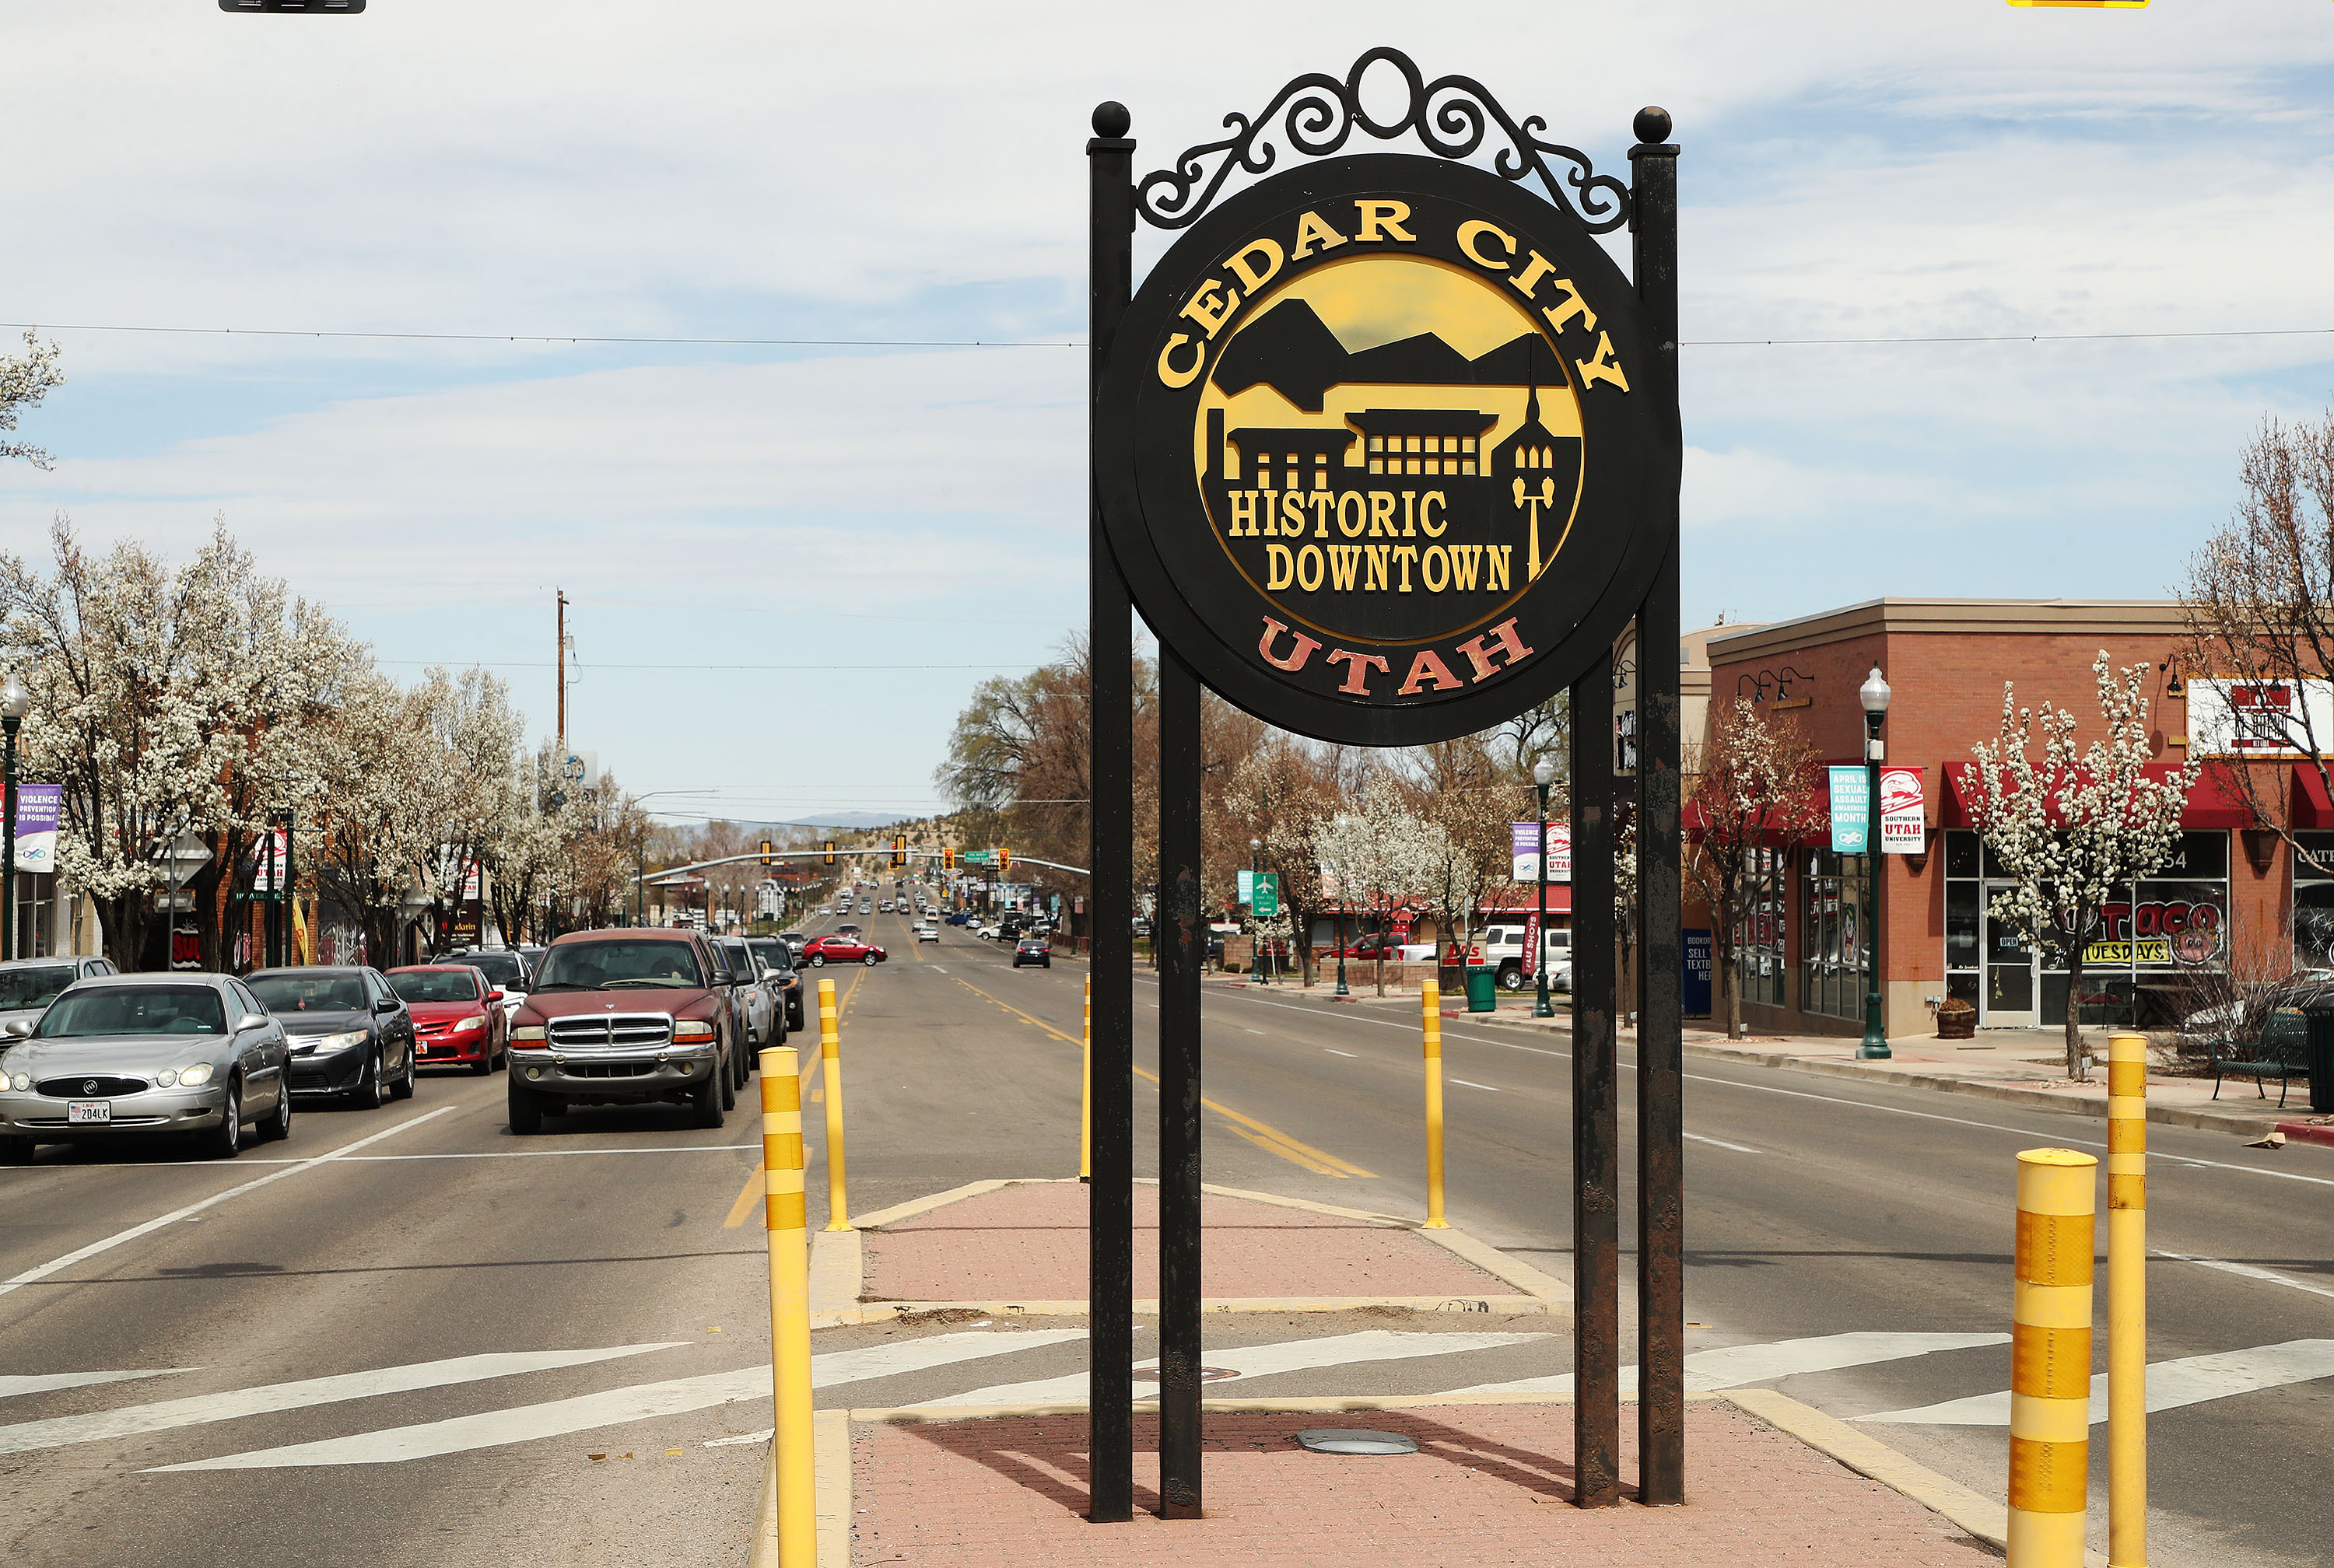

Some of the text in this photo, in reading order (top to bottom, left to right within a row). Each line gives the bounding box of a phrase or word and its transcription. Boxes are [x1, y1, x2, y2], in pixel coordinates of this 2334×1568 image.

[1158, 200, 1631, 394] CEDAR CITY
[1228, 490, 1448, 538] HISTORIC
[1266, 544, 1512, 592] DOWNTOWN
[1259, 615, 1534, 696] UTAH
[1833, 775, 1867, 784] APRIL IS
[1834, 785, 1867, 794] SEXUAL
[19, 795, 58, 804] VIOLENCE
[1835, 795, 1867, 803] ASSAULT
[1835, 813, 1866, 823] MONTH
[1885, 824, 1921, 835] UTAH
[2101, 904, 2217, 941] Taco
[1526, 916, 1537, 949] SHOTS
[1688, 948, 1707, 958] SELL
[2084, 943, 2164, 962] TUESDAYS
